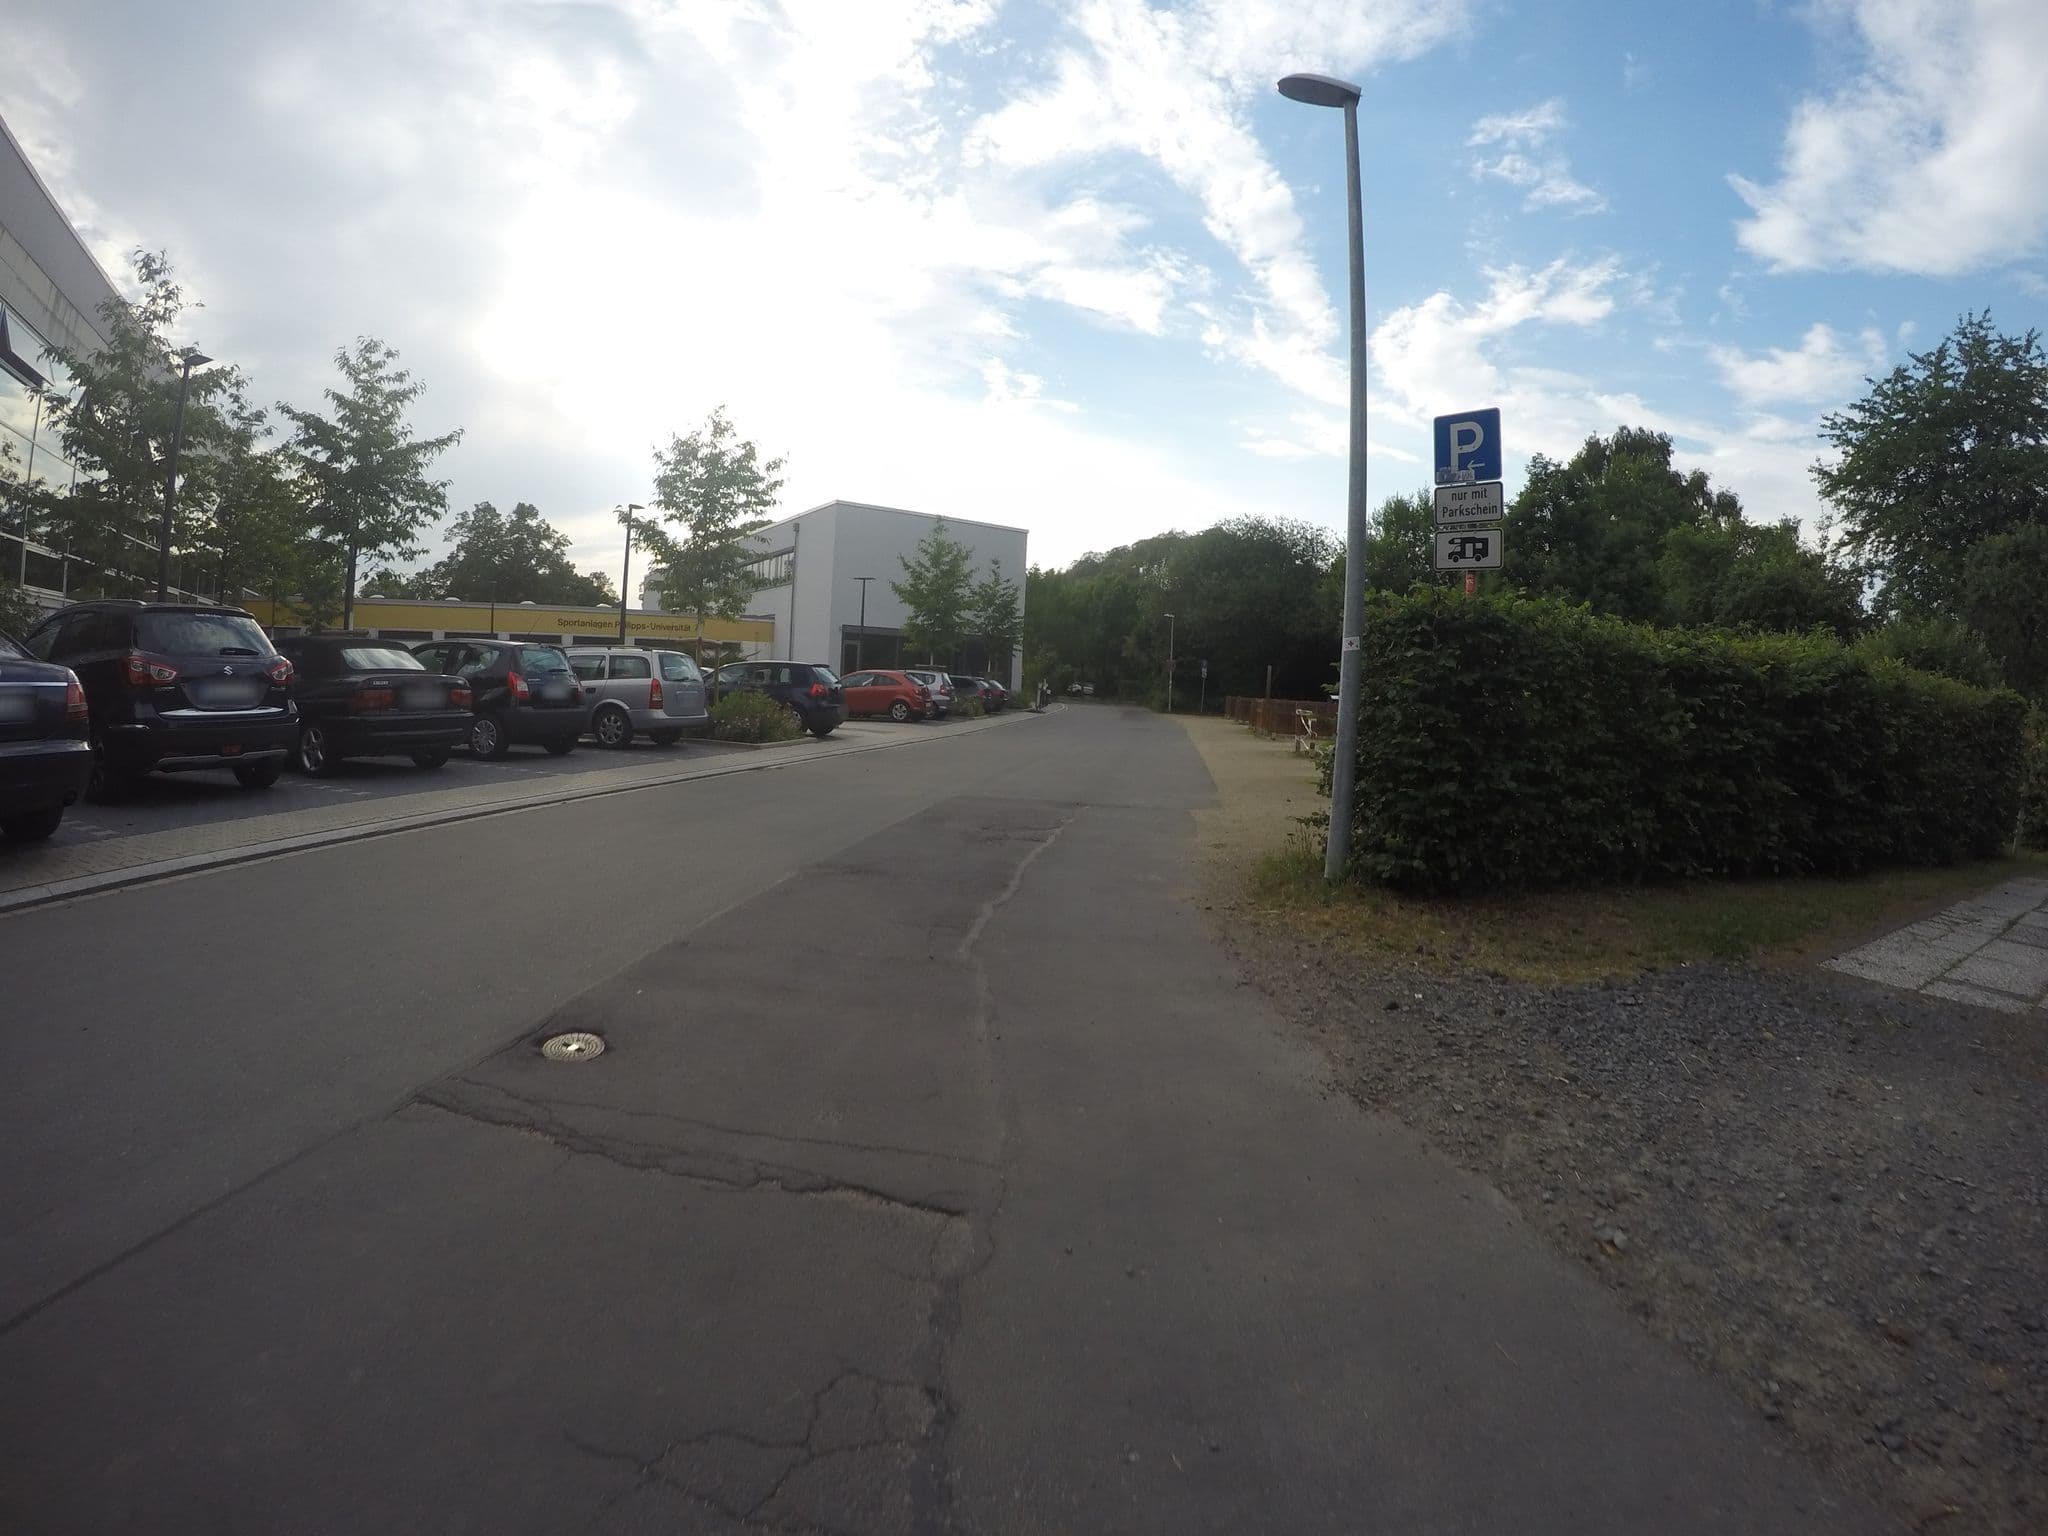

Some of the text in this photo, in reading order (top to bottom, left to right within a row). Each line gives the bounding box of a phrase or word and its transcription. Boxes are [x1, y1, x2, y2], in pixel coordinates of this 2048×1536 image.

[1450, 421, 1484, 474] P
[1451, 487, 1487, 502] nur mit
[1442, 502, 1498, 518] Parkschein
[557, 618, 613, 629] Sportanlagen
